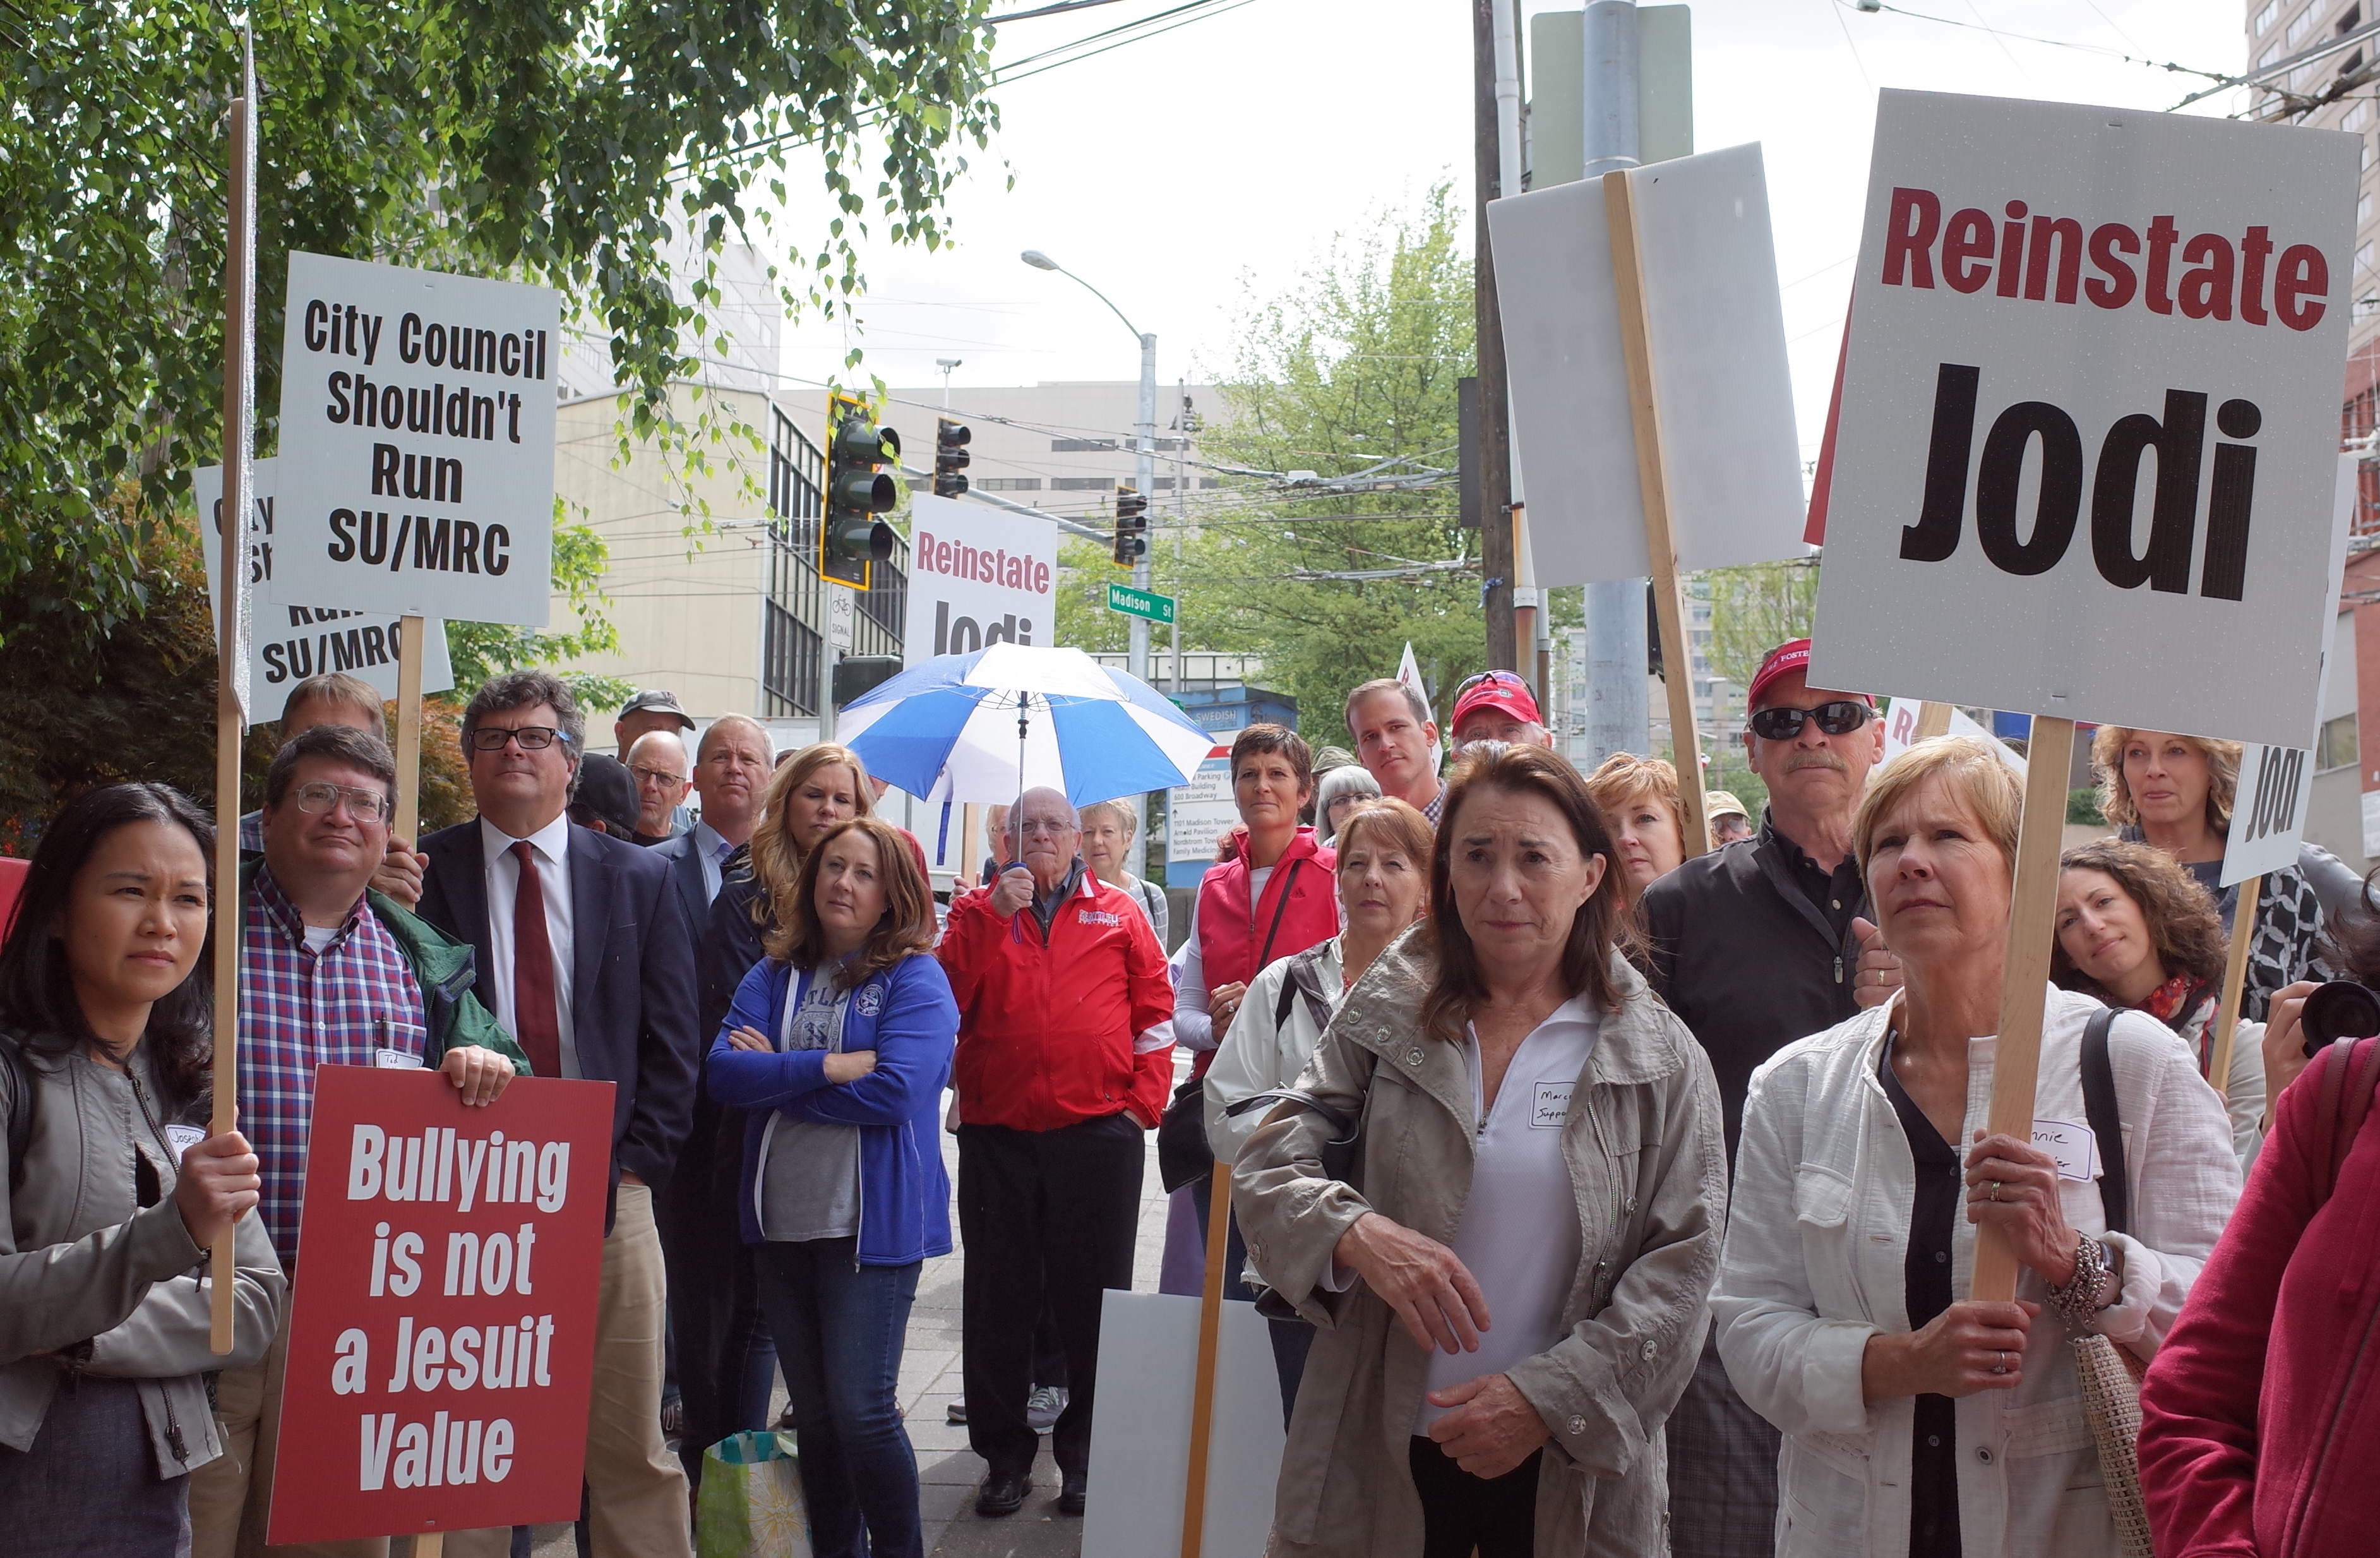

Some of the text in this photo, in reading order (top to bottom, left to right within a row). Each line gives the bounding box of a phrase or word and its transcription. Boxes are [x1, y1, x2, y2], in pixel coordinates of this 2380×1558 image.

[1882, 188, 2328, 332] Reinstate
[304, 299, 547, 380] City Council
[326, 371, 522, 444] Shouldn't
[371, 443, 462, 503] Run
[1899, 363, 2262, 602] Jodi
[328, 508, 510, 576] SU/MRC
[918, 532, 1049, 594] Reinstate
[1111, 589, 1172, 618] Madison St
[1781, 650, 1810, 662] FOSTE
[1196, 710, 1236, 721] SWEDISH
[1185, 792, 1217, 801] Broadway
[1191, 782, 1216, 791] Building
[1536, 1107, 1567, 1121] Suppo
[347, 1124, 570, 1213] Bullying
[369, 1221, 536, 1297] is not
[332, 1314, 554, 1395] a Jesuit
[360, 1411, 514, 1491] Value
